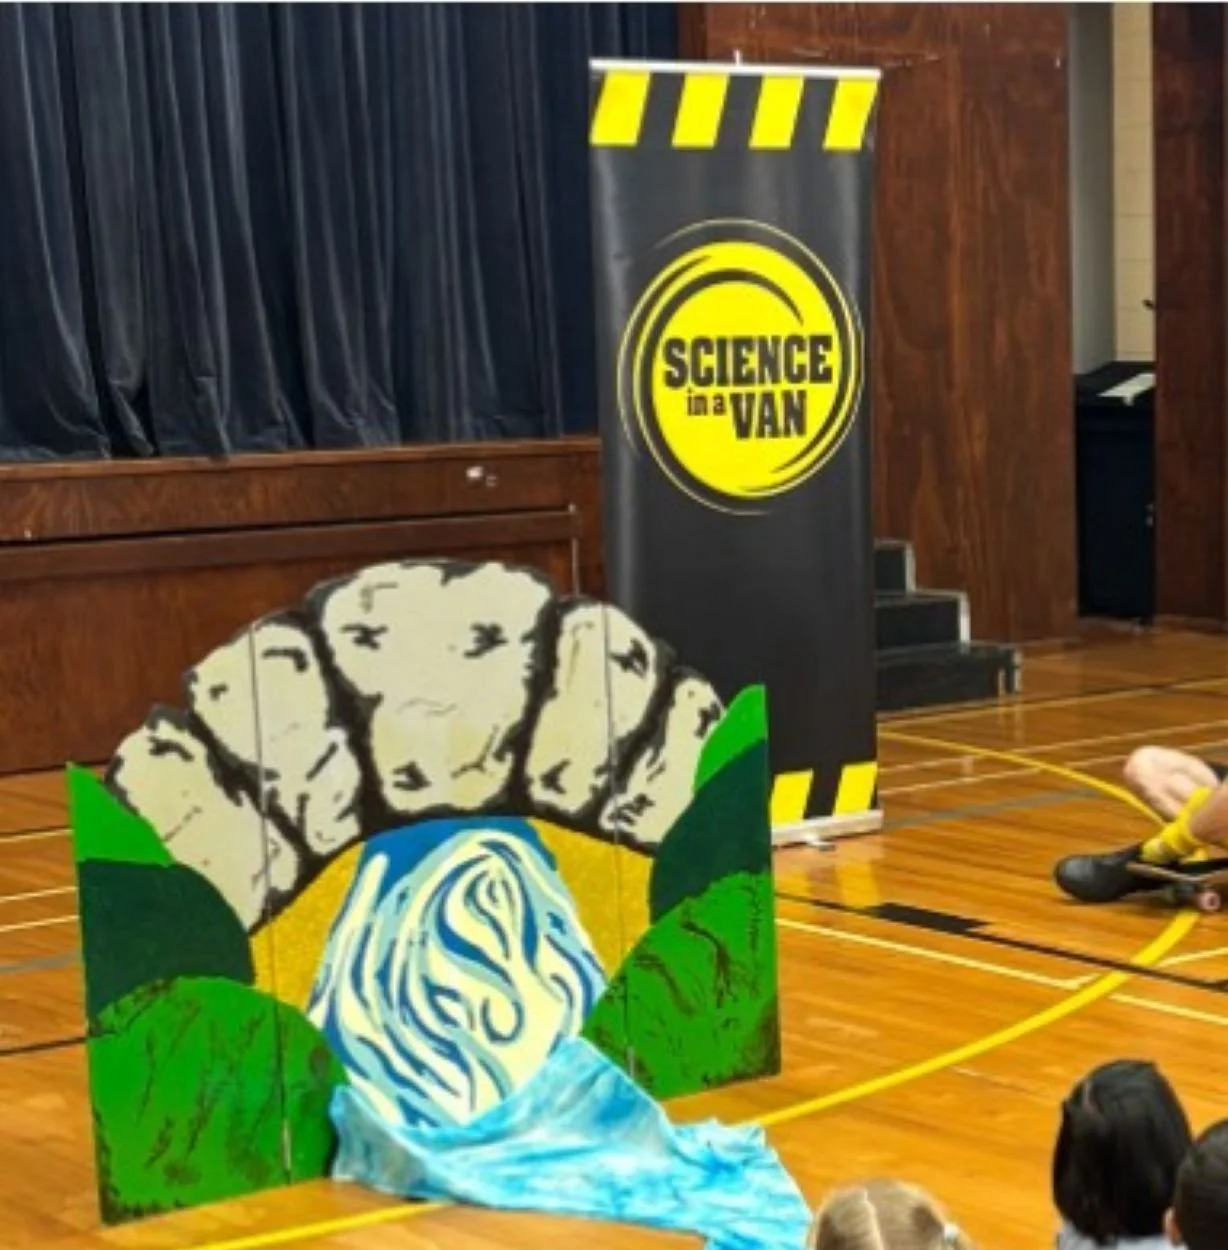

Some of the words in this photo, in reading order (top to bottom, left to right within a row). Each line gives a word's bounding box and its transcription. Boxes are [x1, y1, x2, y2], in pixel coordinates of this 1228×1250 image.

[663, 335, 833, 389] SCIENCE
[687, 388, 708, 416] in
[713, 396, 725, 416] a
[729, 389, 807, 439] VAN
